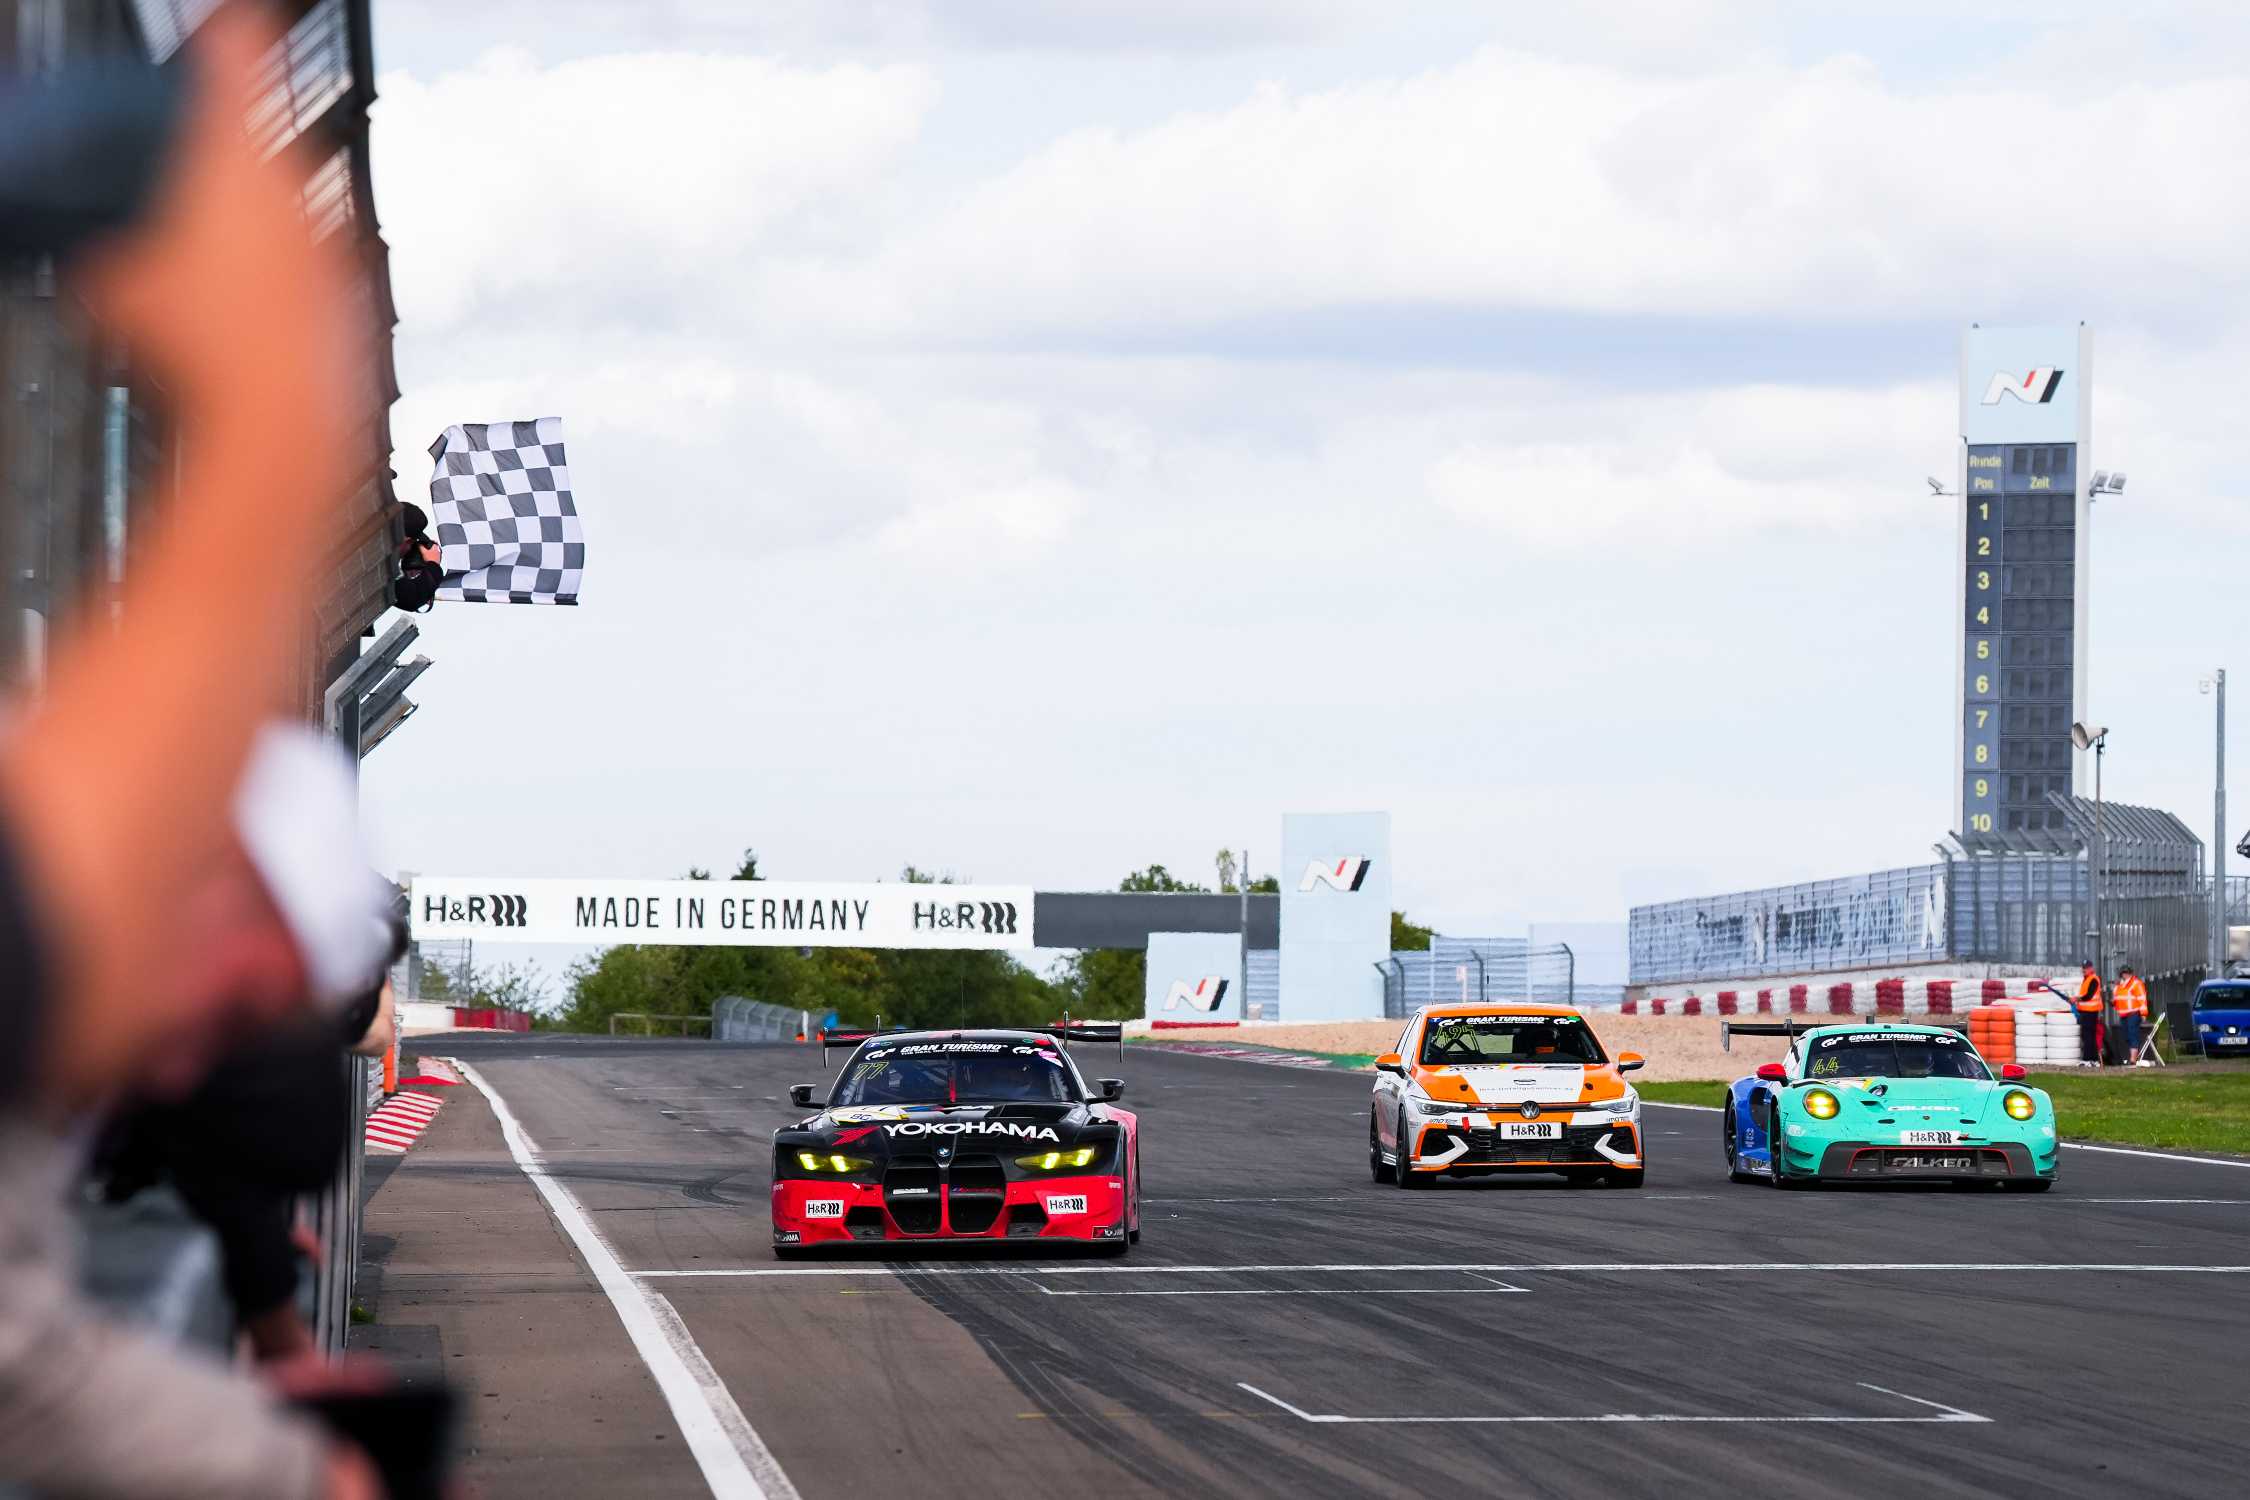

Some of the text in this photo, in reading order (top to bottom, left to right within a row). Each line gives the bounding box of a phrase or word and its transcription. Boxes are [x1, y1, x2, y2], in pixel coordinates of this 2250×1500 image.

[1969, 455, 2002, 468] Runde
[1975, 476, 1994, 489] Pos
[2029, 476, 2050, 489] Zeit
[1979, 504, 1989, 520] 1
[1978, 538, 1990, 555] 2
[1978, 571, 1990, 589] 3
[1976, 608, 1989, 625] 4
[1977, 640, 1989, 658] 5
[1976, 676, 1988, 693] 6
[1976, 711, 1988, 728] 7
[1976, 745, 1988, 763] 8
[1976, 780, 1988, 797] 9
[1971, 814, 1991, 832] 10
[426, 897, 485, 921] H&R
[577, 897, 868, 929] MADE IN GERMANY
[915, 903, 974, 928] H&R
[900, 1044, 939, 1053] GRAN
[854, 1061, 889, 1080] 77
[1812, 1056, 1839, 1075] 44
[883, 1121, 1060, 1143] YOKOHAMA
[1511, 1125, 1535, 1136] H&R
[1910, 1132, 1936, 1142] H&R
[1892, 1157, 1971, 1168] FALKEN
[807, 1203, 827, 1214] H&R
[1050, 1199, 1070, 1210] H&R
